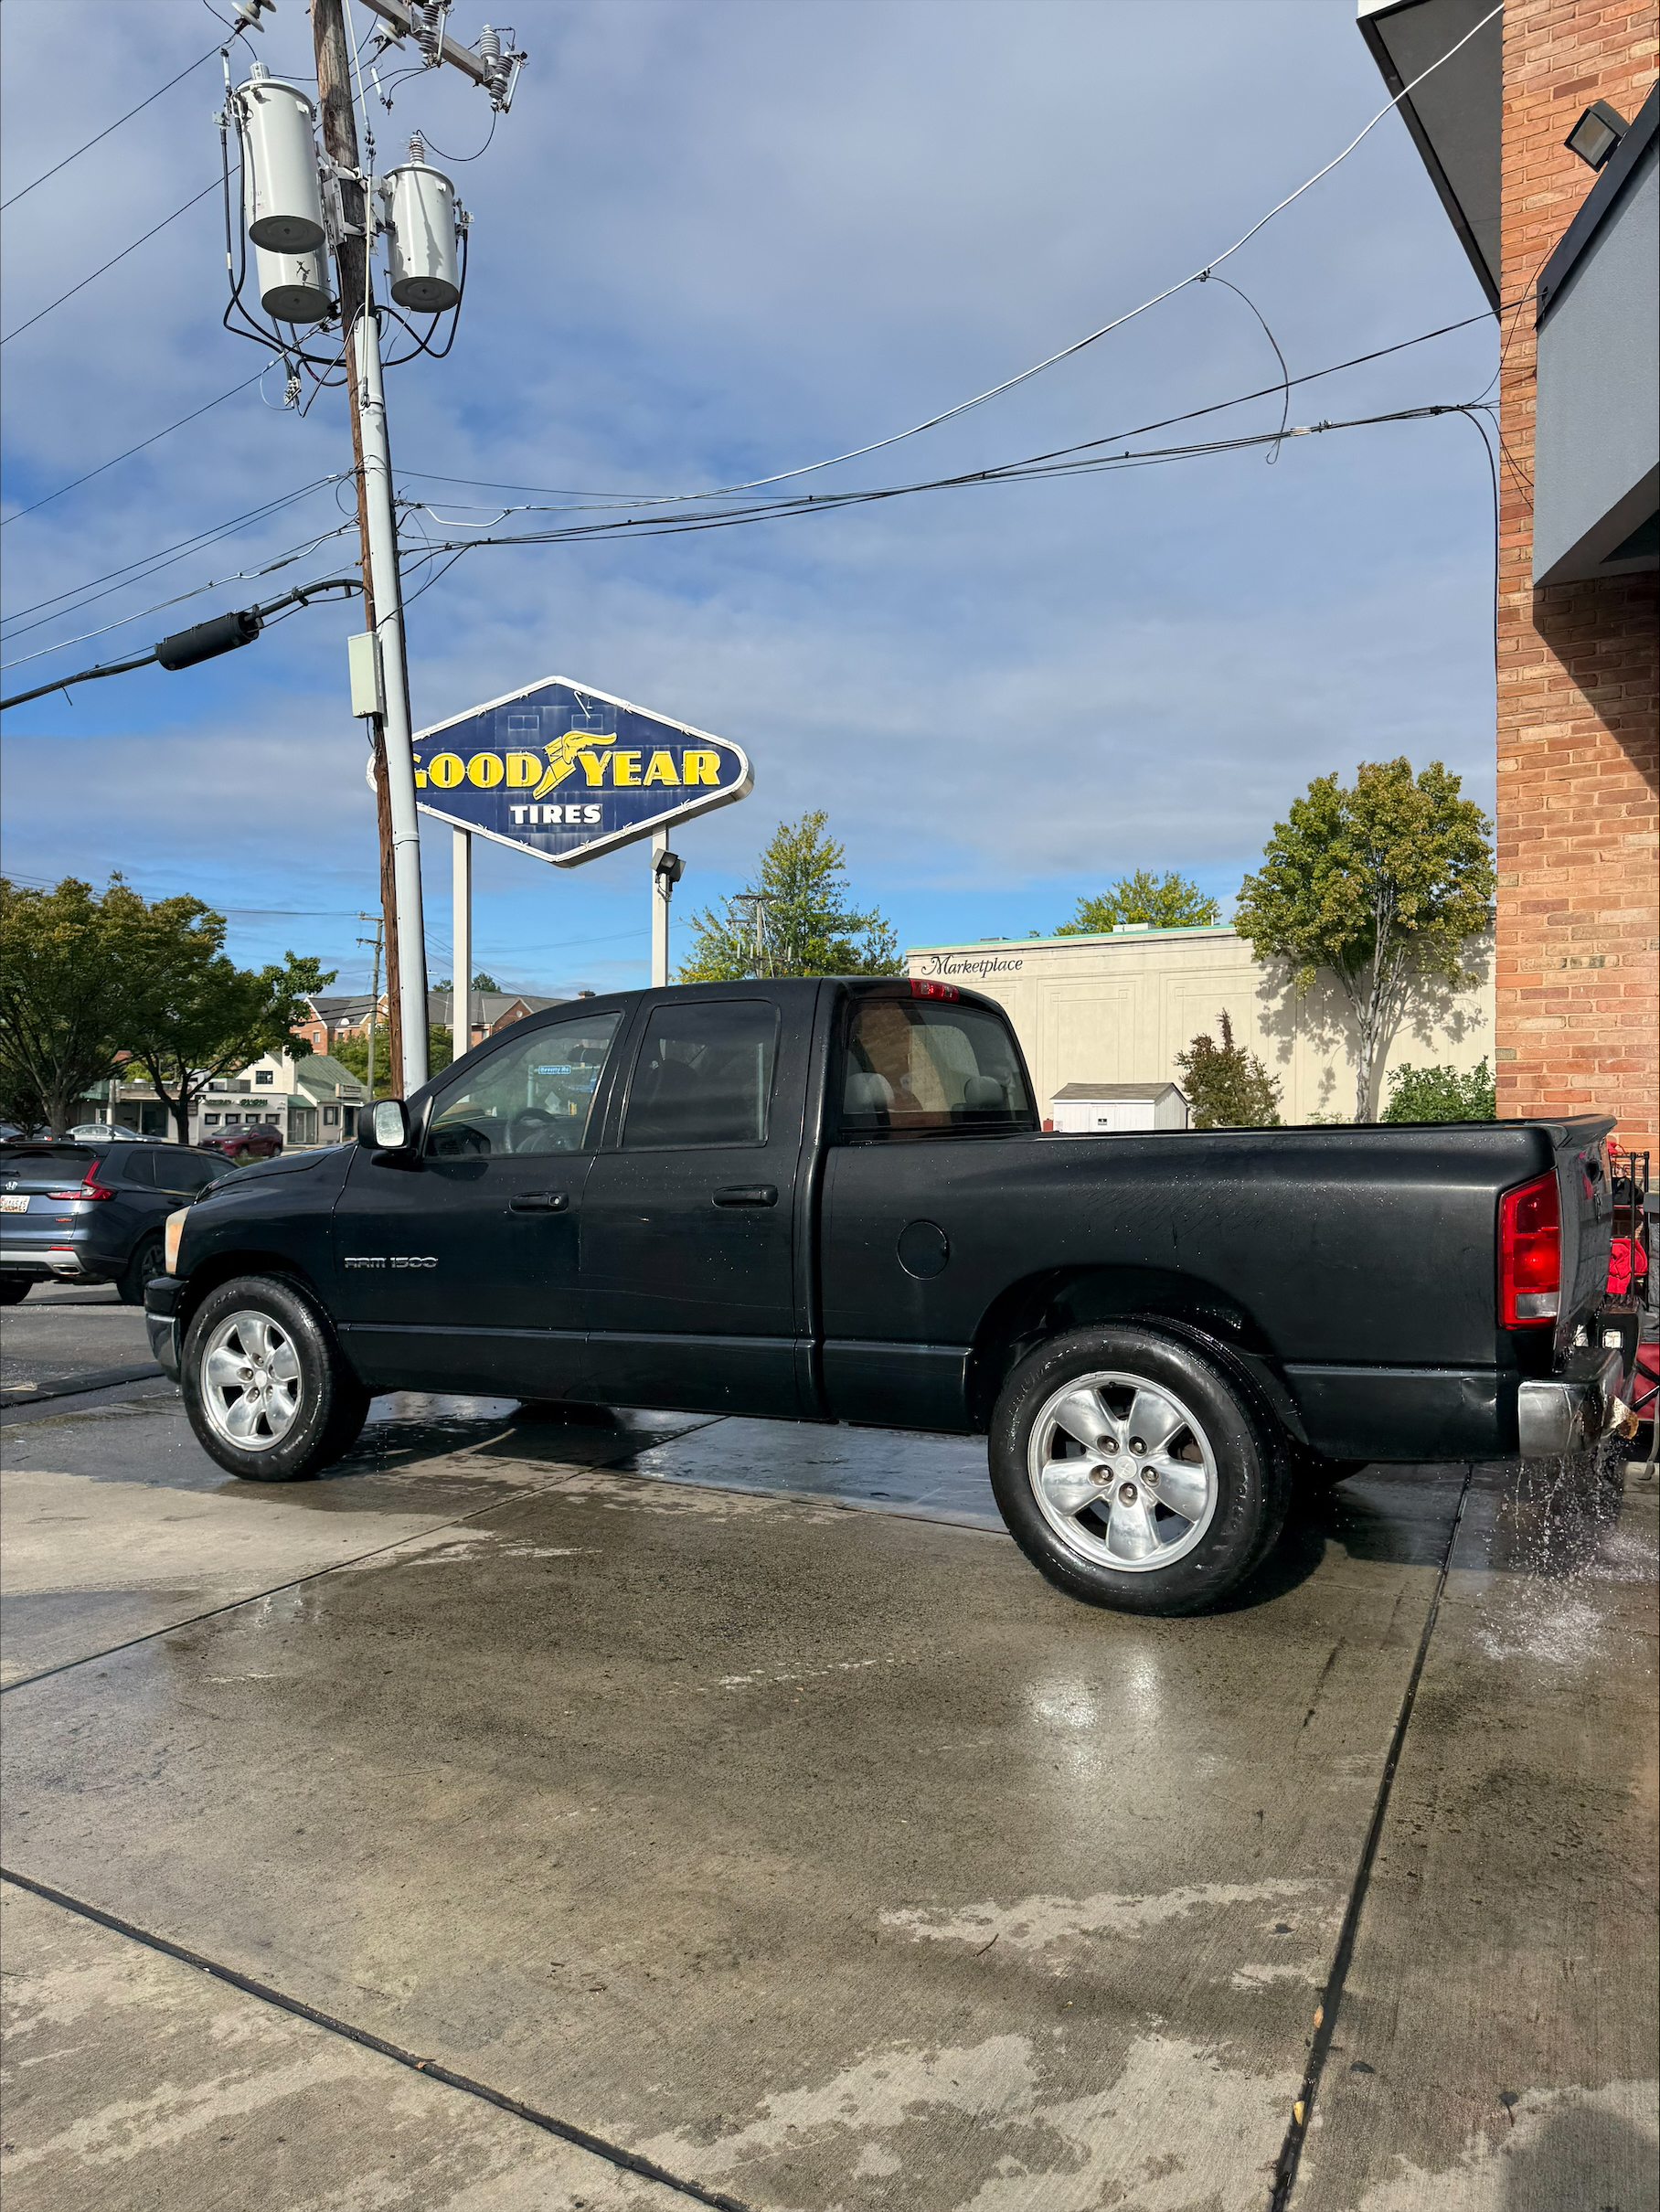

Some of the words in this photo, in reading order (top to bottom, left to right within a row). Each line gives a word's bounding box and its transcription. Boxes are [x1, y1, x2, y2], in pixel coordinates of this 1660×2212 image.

[510, 804, 601, 824] TIRES
[920, 954, 1023, 978] Marketplace
[344, 1257, 387, 1268] RAM
[389, 1257, 439, 1268] 1500
